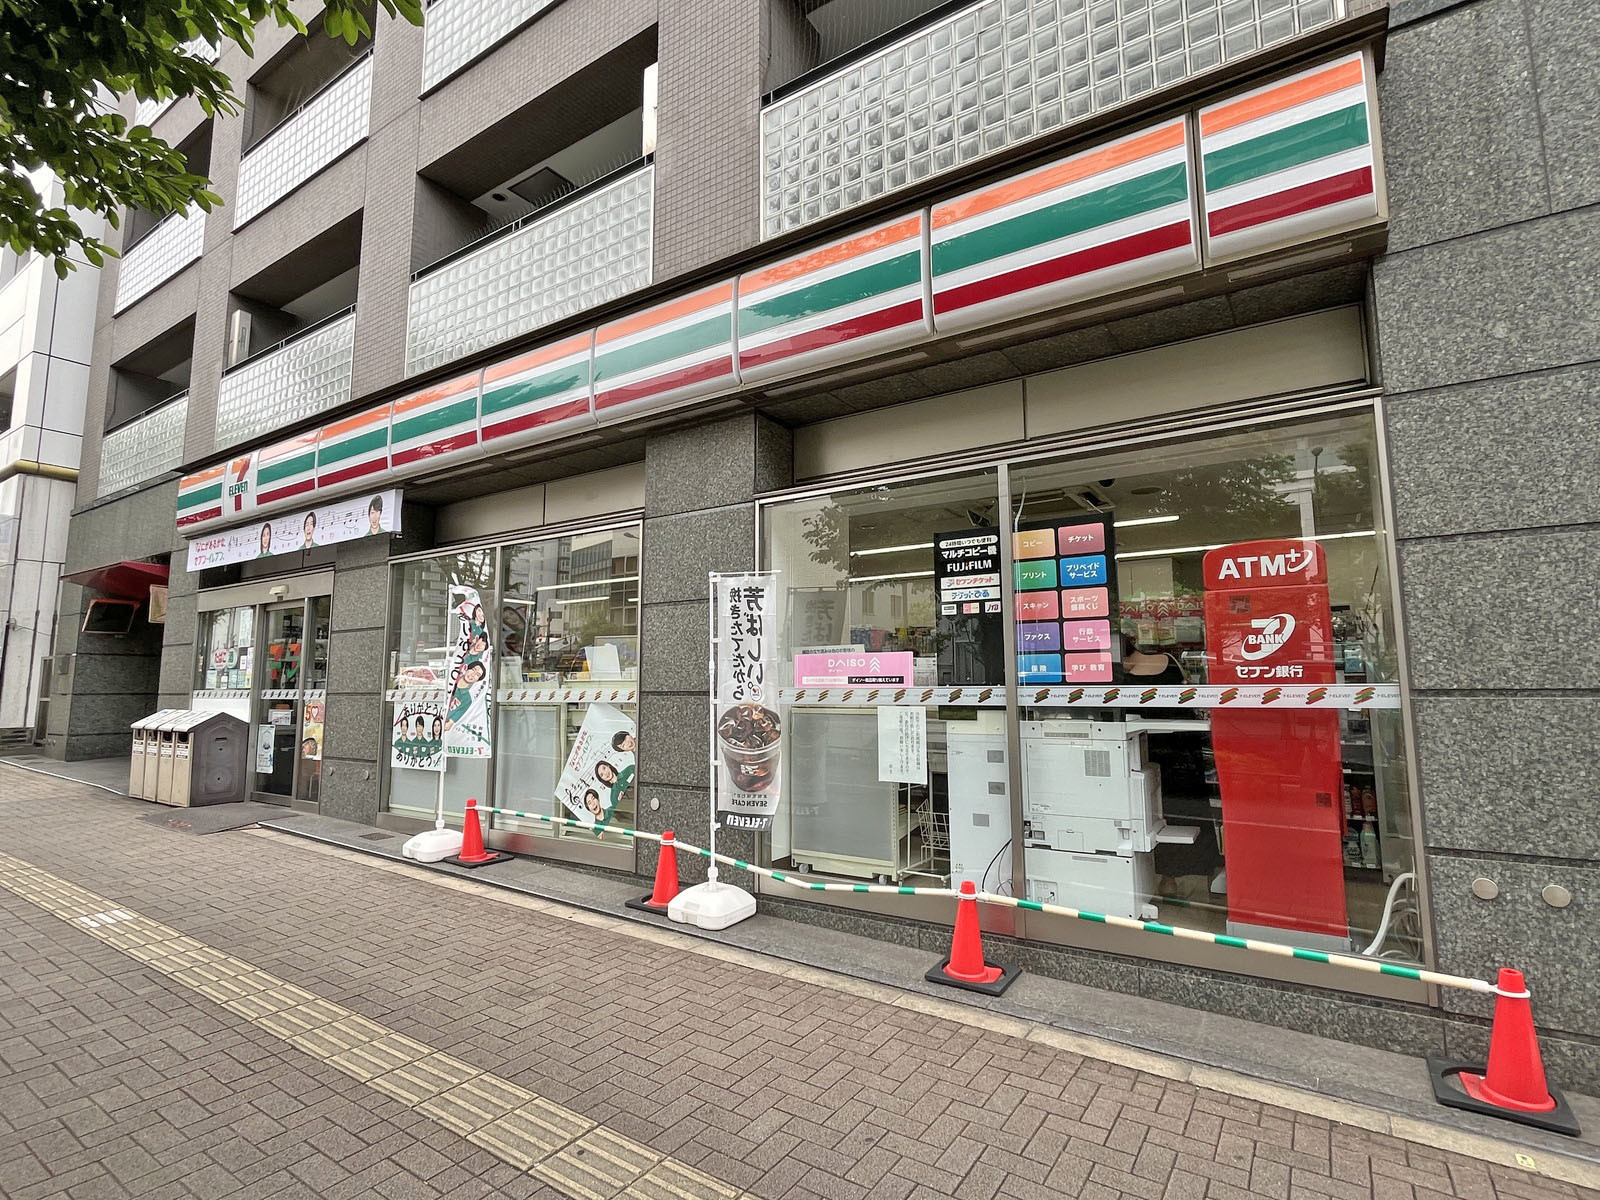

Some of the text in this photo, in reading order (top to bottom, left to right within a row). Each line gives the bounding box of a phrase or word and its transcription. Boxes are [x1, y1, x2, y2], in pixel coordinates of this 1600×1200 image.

[1068, 533, 1094, 543] チケット
[1023, 540, 1043, 548] コピー
[1065, 562, 1100, 572] プリペイド
[1022, 571, 1047, 580] プリント
[1069, 570, 1098, 579] サービス
[1023, 602, 1049, 610] スキャン
[1024, 633, 1051, 641] ファクス
[1072, 635, 1101, 643] サービス
[1248, 634, 1284, 645] BANK
[828, 658, 866, 668] DAISO
[1235, 665, 1304, 678] セブン銀行
